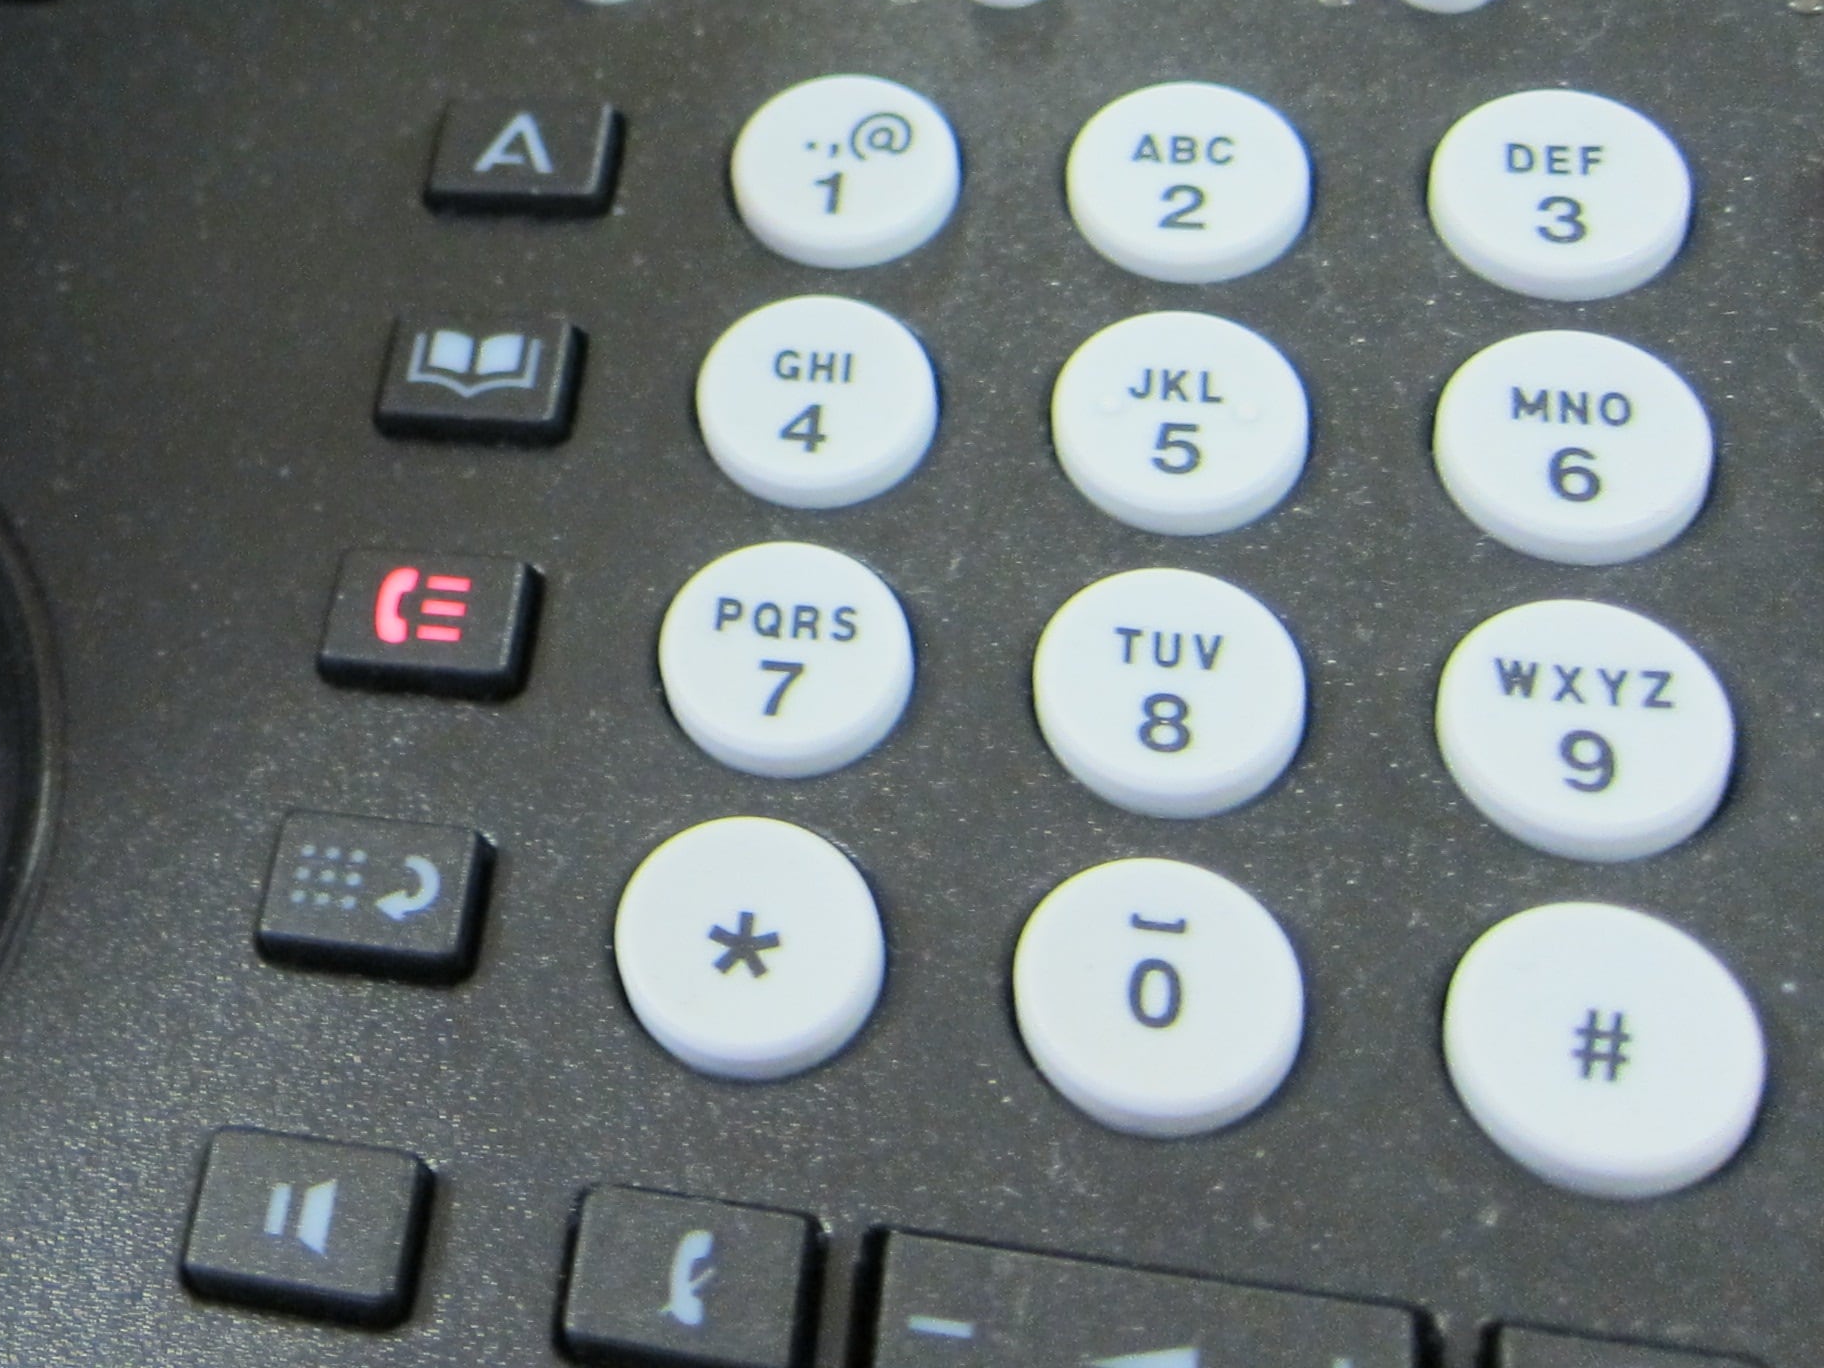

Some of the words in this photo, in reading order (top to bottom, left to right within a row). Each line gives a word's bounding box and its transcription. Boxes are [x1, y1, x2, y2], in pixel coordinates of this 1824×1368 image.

[1130, 132, 1236, 167] ABC
[1504, 141, 1605, 177] DEF
[813, 170, 845, 216] 1
[1157, 182, 1207, 231] 2
[1534, 194, 1589, 246] 3
[772, 348, 855, 384] GHI
[1127, 367, 1225, 405] JKL
[778, 402, 828, 454] 4
[1509, 385, 1634, 429] MNO
[1150, 420, 1203, 476] 5
[1546, 445, 1603, 504] 6
[712, 595, 860, 644] PQRS
[1114, 625, 1225, 672] TUV
[758, 658, 806, 718] 7
[1492, 656, 1676, 711] WXYZ
[1136, 691, 1193, 755] 8
[1558, 728, 1618, 795] 9
[1126, 956, 1184, 1031] 0
[1571, 1008, 1632, 1083] #
